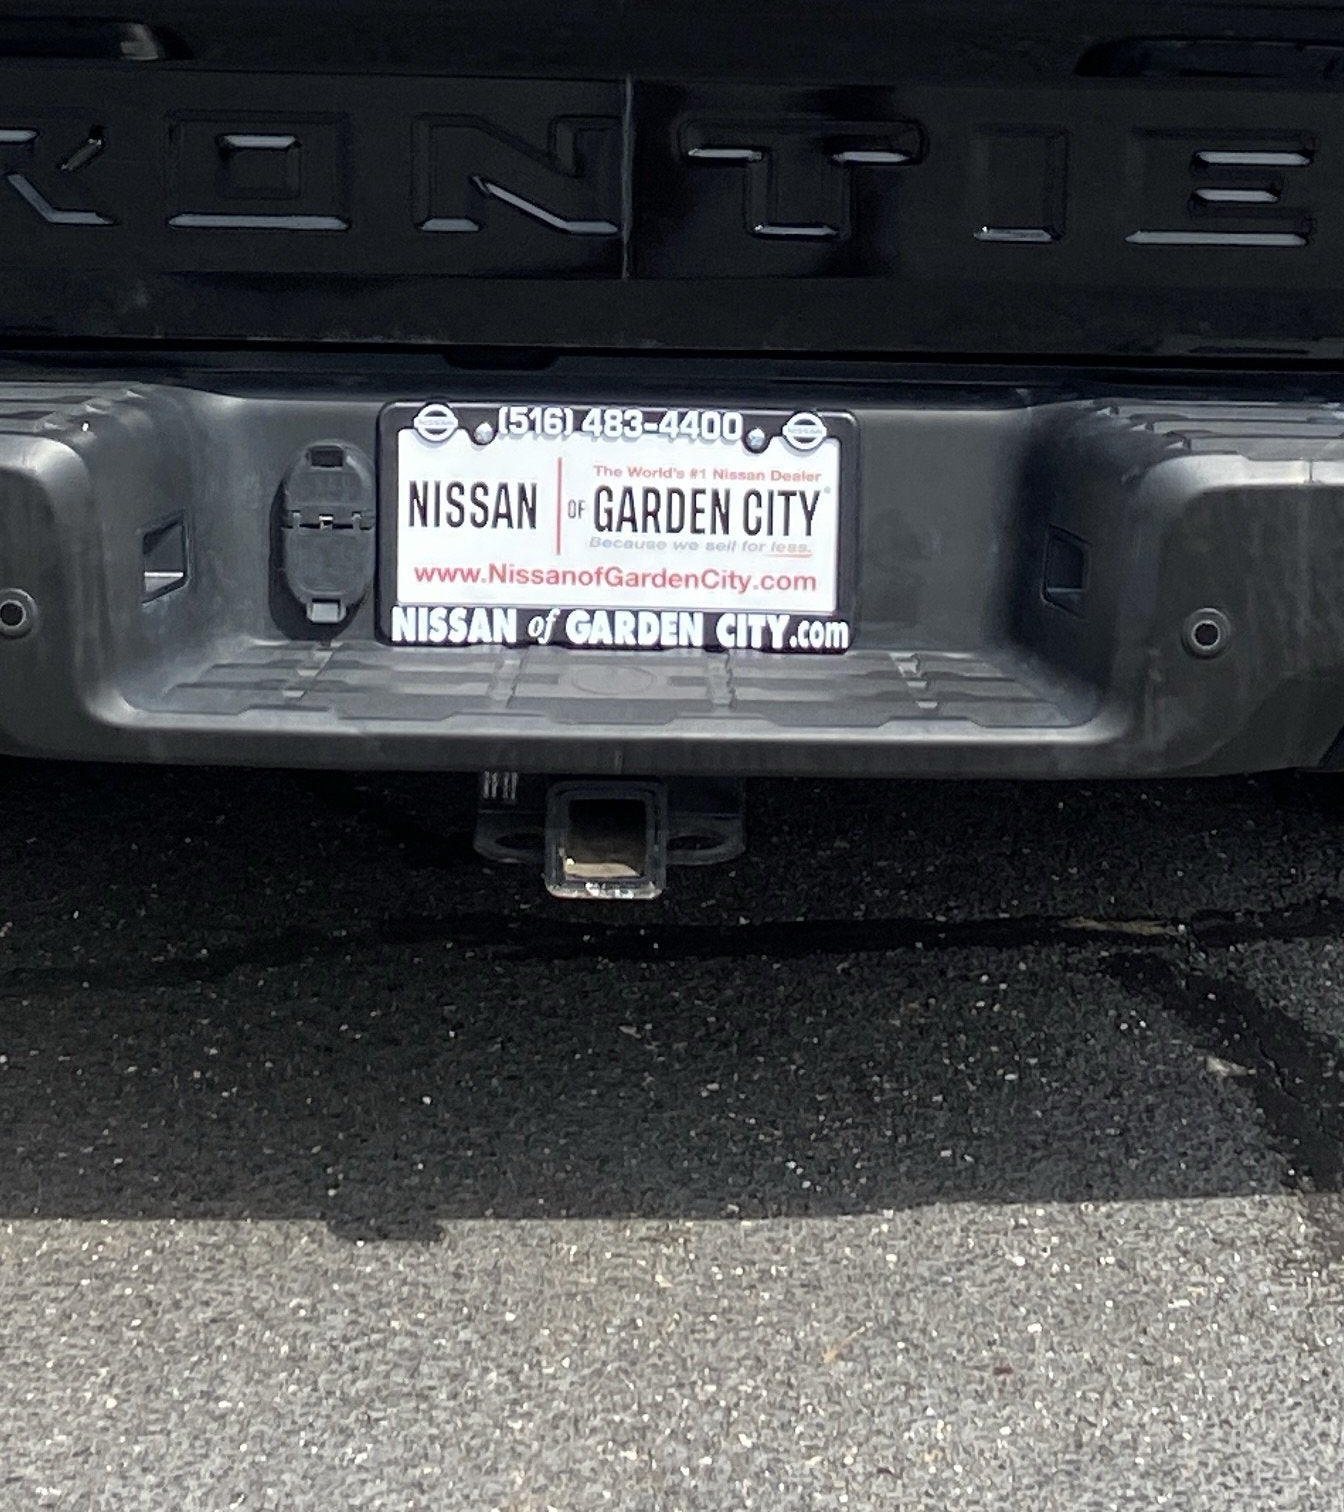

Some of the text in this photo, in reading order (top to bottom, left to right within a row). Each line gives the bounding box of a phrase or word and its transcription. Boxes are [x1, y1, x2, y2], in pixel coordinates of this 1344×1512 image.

[498, 406, 743, 440] (516) 483-4400
[593, 465, 823, 483] The World's #1 Nissan Dealer
[408, 480, 821, 536] NISSAN OF GARDEN CITY
[589, 536, 812, 555] Because we sell for less.
[414, 563, 817, 595] www.NissanofGardenCity.com
[391, 607, 850, 650] NISSAN of GARDEN CITY.com
